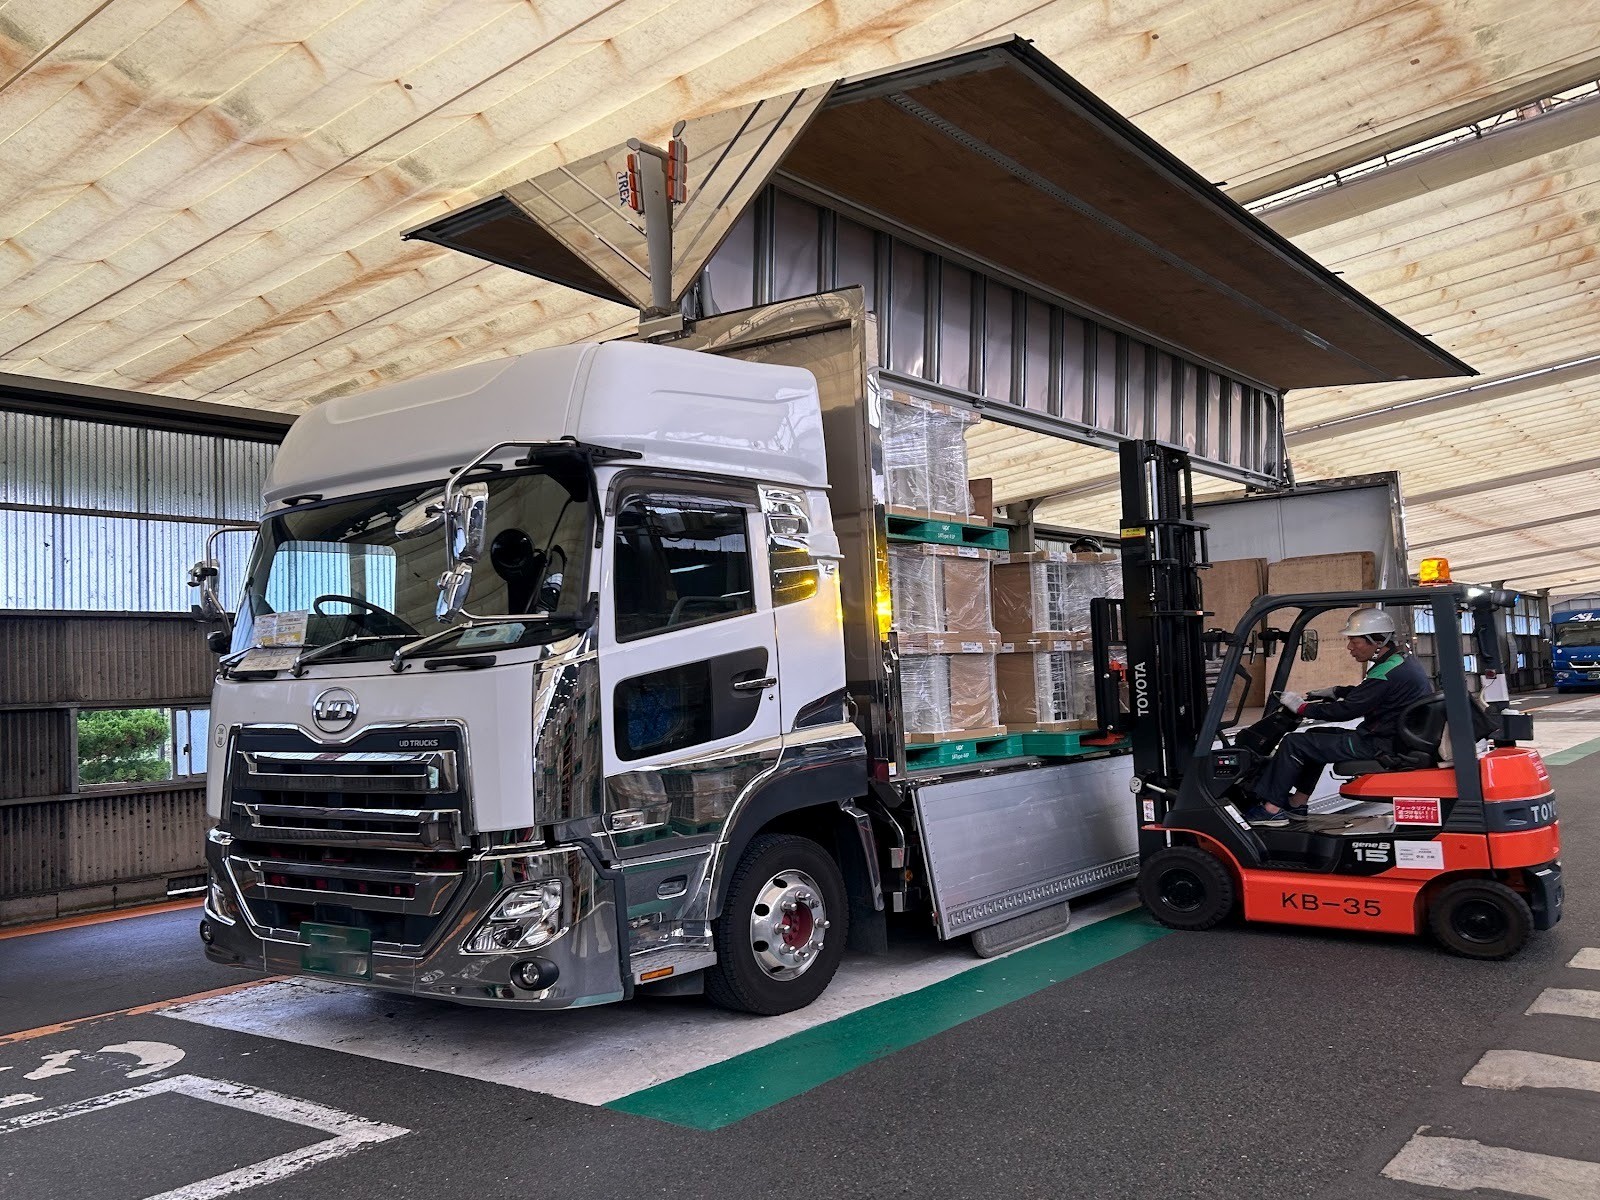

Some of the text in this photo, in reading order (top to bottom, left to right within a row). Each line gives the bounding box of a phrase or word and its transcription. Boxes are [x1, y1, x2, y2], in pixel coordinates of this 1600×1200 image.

[1134, 661, 1149, 716] TOYOTA
[315, 700, 354, 720] UD
[1354, 849, 1389, 862] 15
[1282, 892, 1381, 917] KB-35
